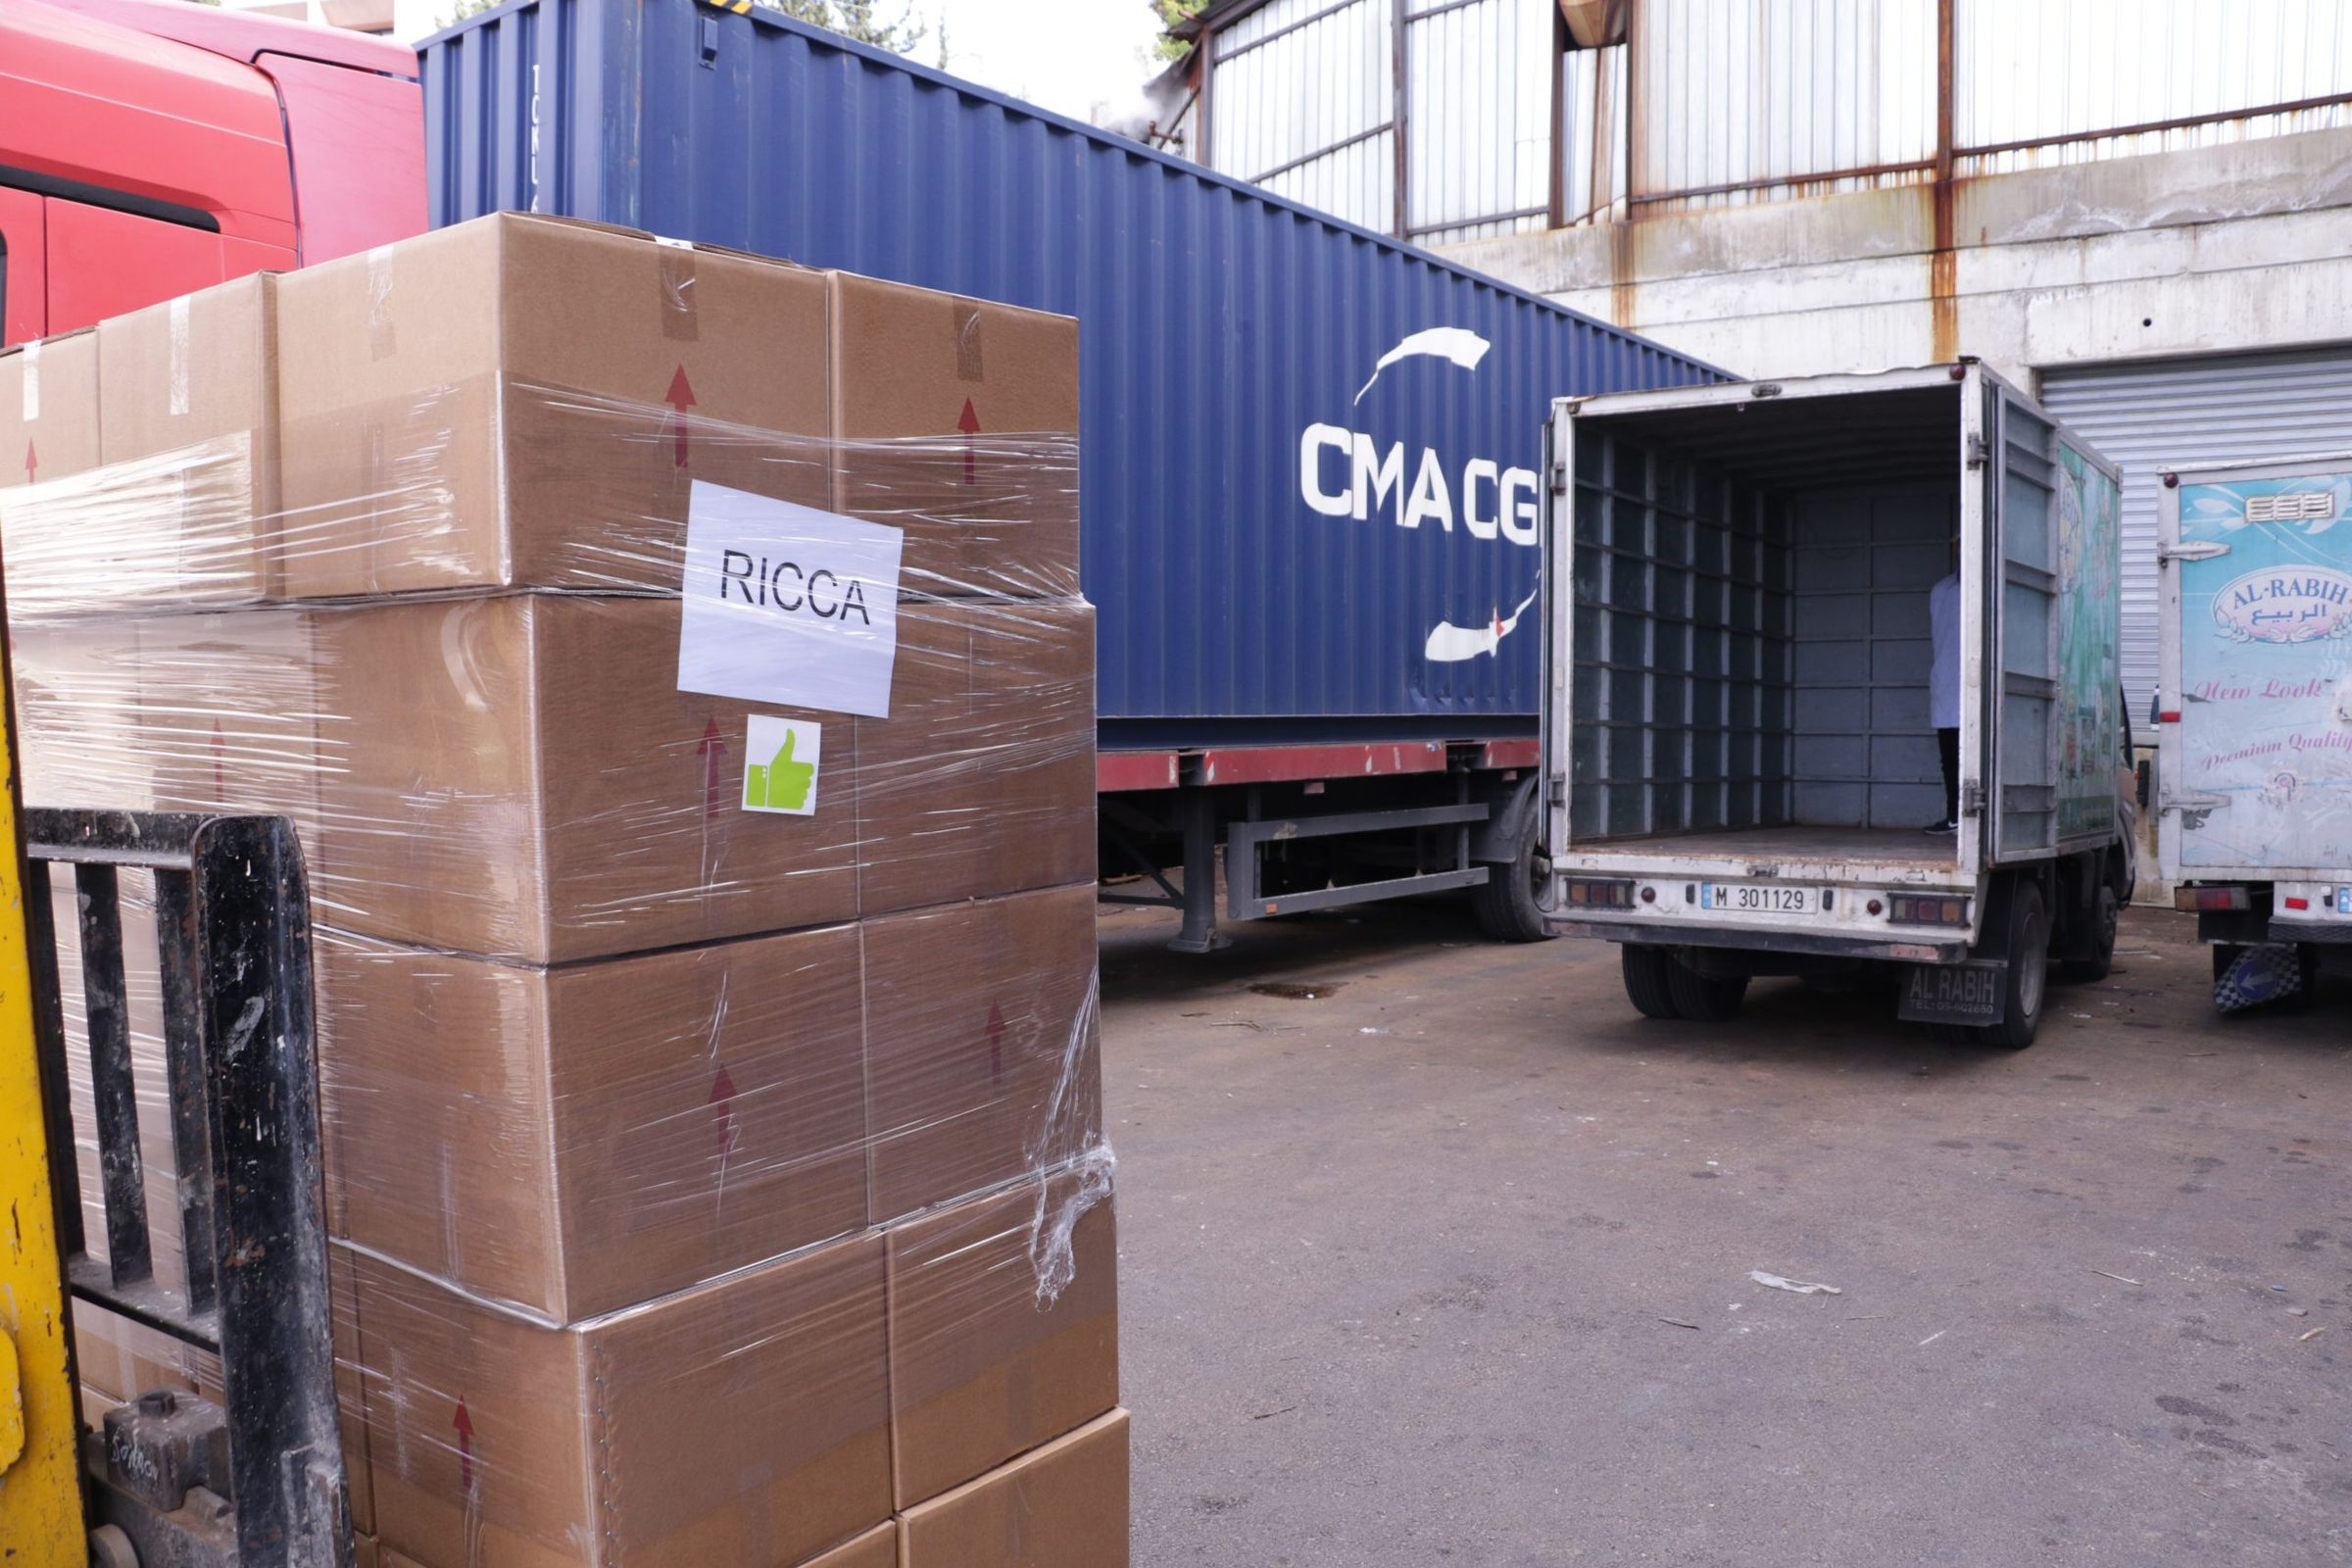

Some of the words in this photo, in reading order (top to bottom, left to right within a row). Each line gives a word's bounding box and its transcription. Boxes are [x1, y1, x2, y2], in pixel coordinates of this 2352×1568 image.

[1300, 421, 1453, 532] CMA
[1463, 457, 1544, 549] CG
[720, 549, 870, 625] RICCA
[2251, 603, 2327, 625] الربيع
[2194, 680, 2250, 700] New
[2258, 677, 2322, 699] Look
[2202, 741, 2282, 770] Premium
[2288, 730, 2352, 753] Quality
[1716, 886, 1728, 906] M
[1739, 888, 1804, 910] 301129
[1909, 967, 1934, 999] AL
[1939, 969, 1995, 1004] RABIH
